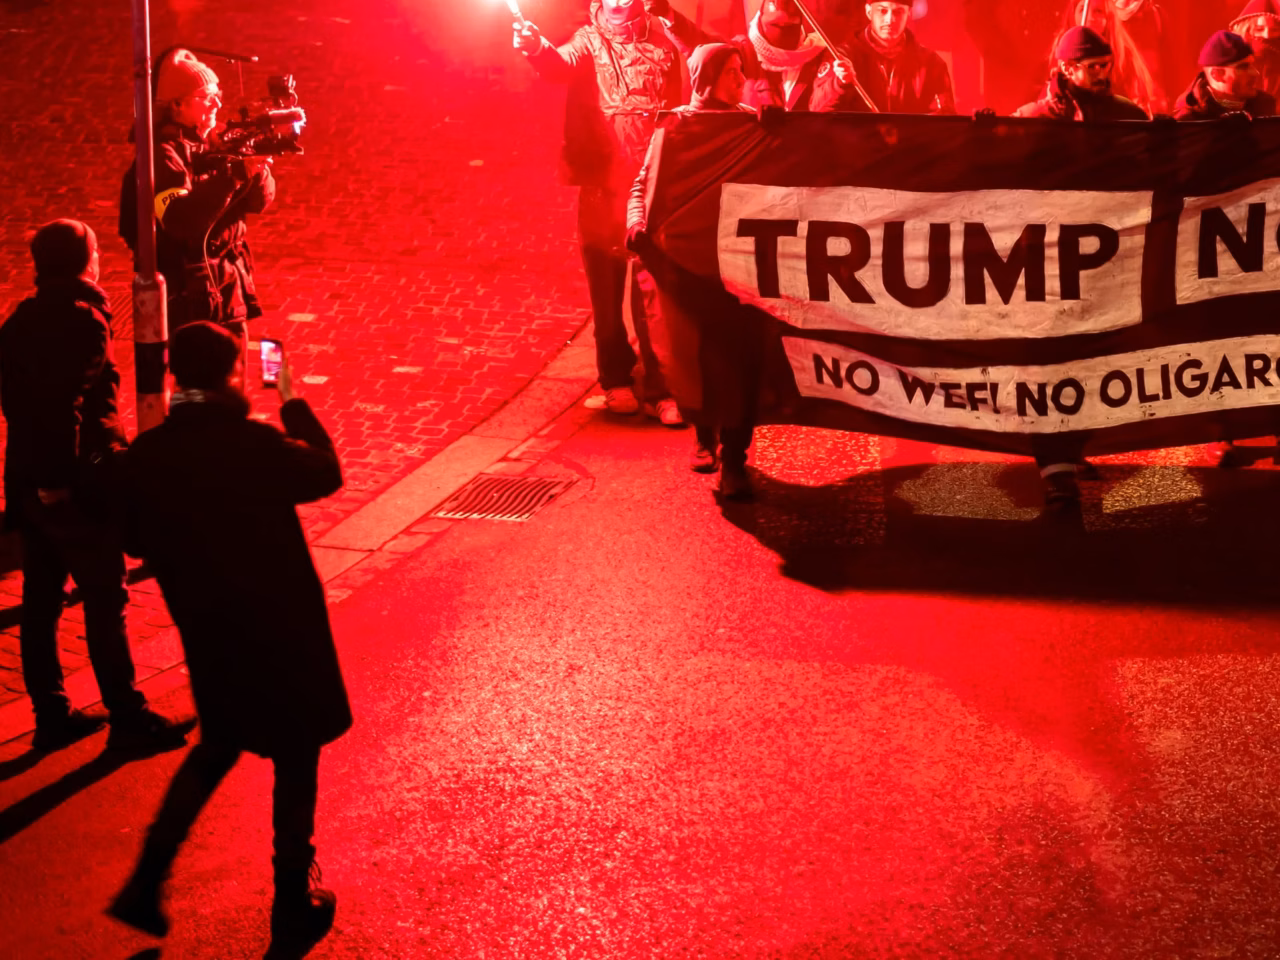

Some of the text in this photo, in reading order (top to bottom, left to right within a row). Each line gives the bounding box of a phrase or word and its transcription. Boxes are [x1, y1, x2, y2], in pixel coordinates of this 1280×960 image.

[736, 218, 1121, 308] TRUMP
[812, 353, 881, 396] NO
[897, 368, 1001, 415] WEF!
[1015, 377, 1086, 417] NO
